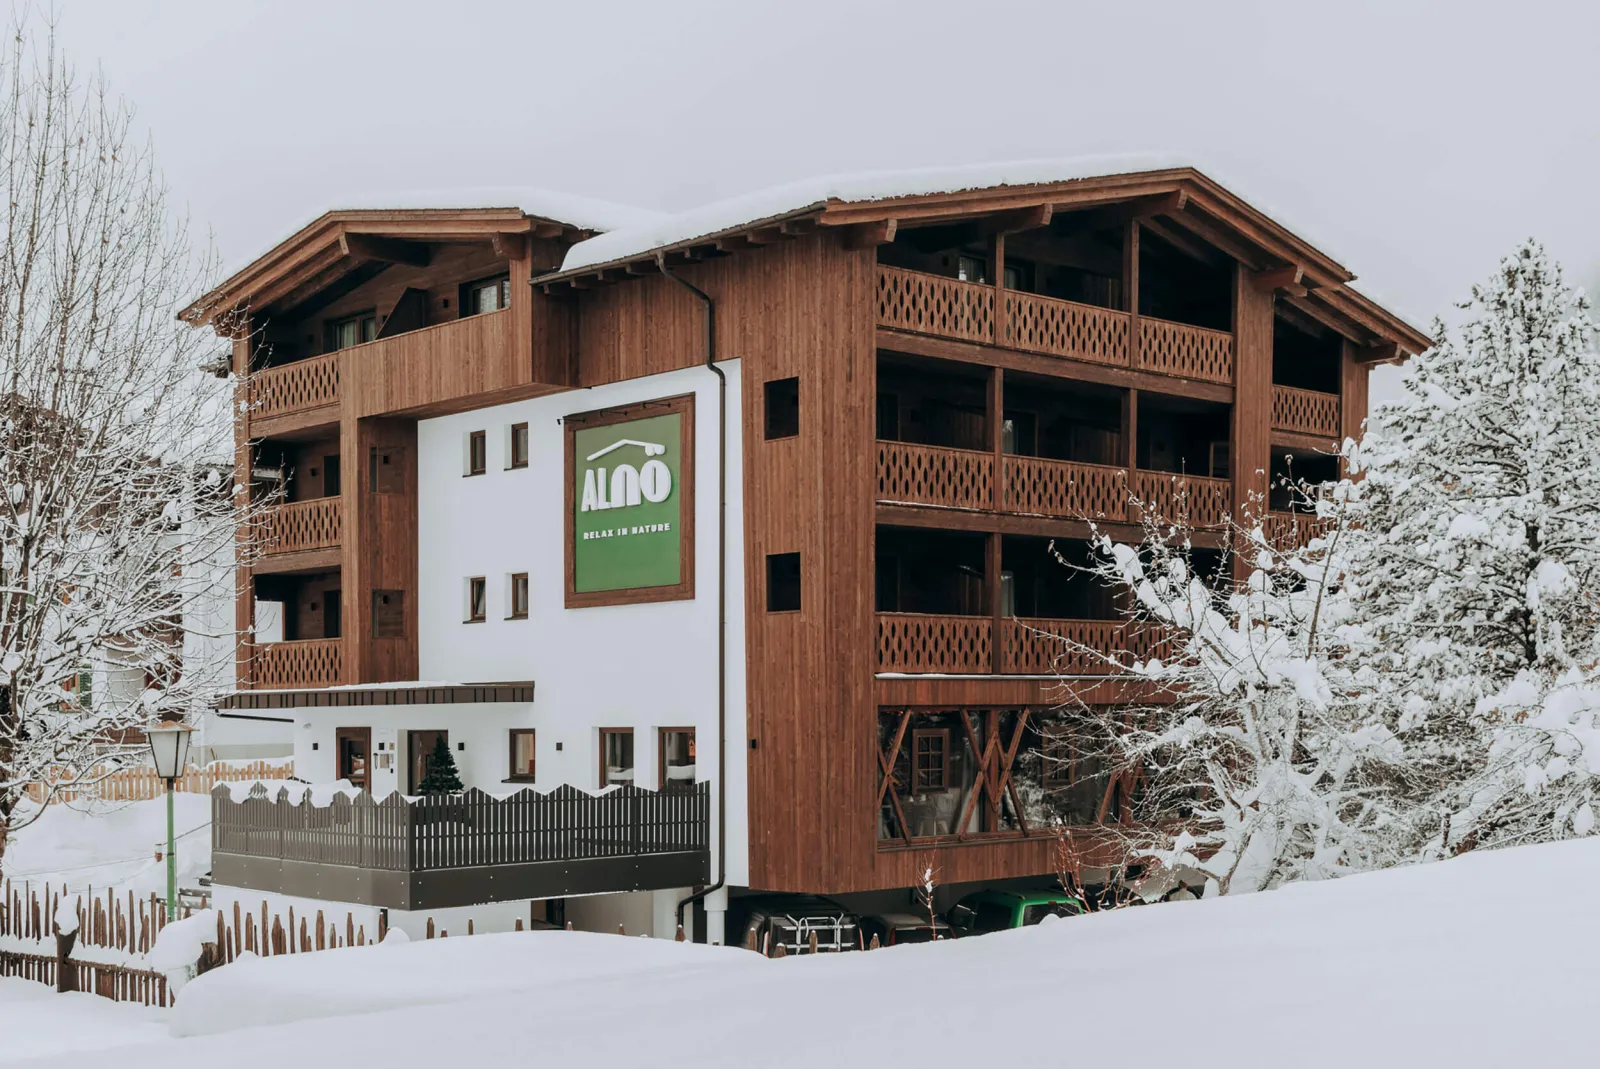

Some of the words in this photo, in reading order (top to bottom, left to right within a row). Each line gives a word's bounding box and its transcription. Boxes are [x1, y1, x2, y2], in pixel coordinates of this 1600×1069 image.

[583, 529, 614, 540] RELAX
[617, 527, 628, 536] IN
[631, 522, 670, 534] NATURE
